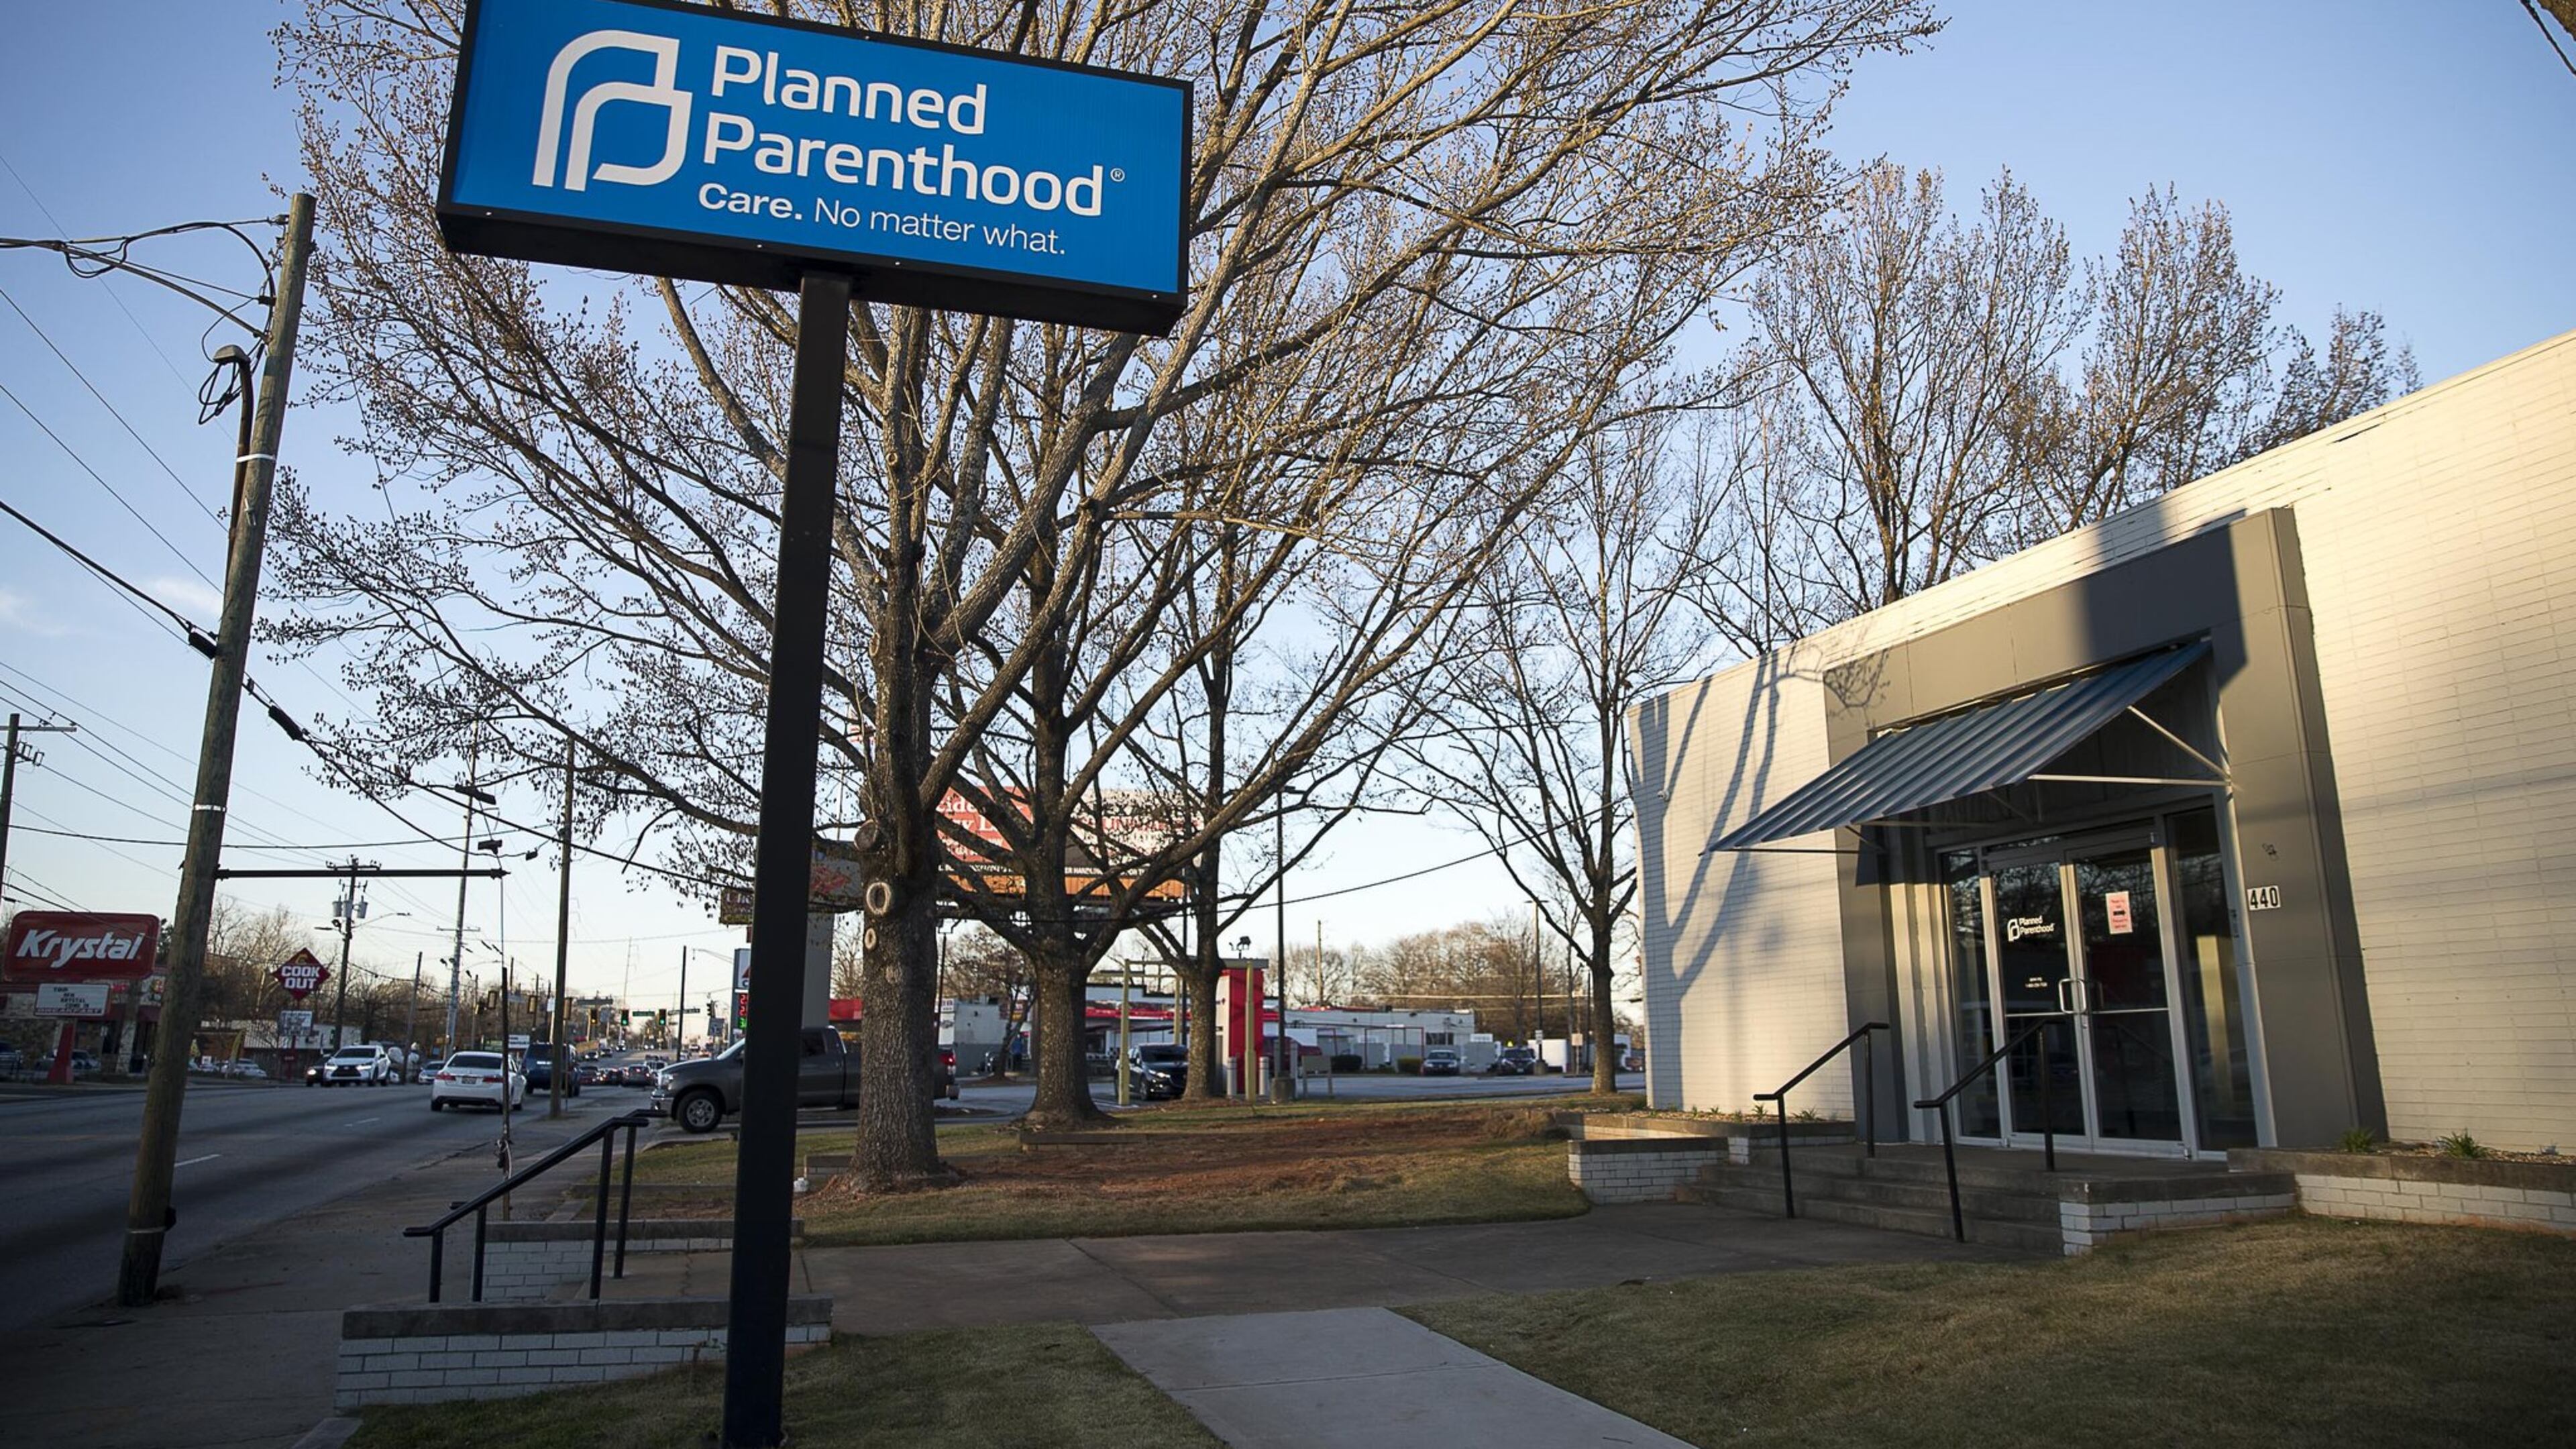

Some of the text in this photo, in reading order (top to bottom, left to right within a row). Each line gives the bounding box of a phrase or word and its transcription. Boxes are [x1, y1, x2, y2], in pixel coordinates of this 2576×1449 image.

[711, 45, 987, 134] Planned
[698, 182, 1066, 255] Care. No matter what.
[2251, 887, 2279, 908] 440
[2019, 915, 2043, 926] Planned
[16, 928, 146, 968] Krystal
[281, 965, 321, 977] COOK
[284, 977, 317, 989] OUT
